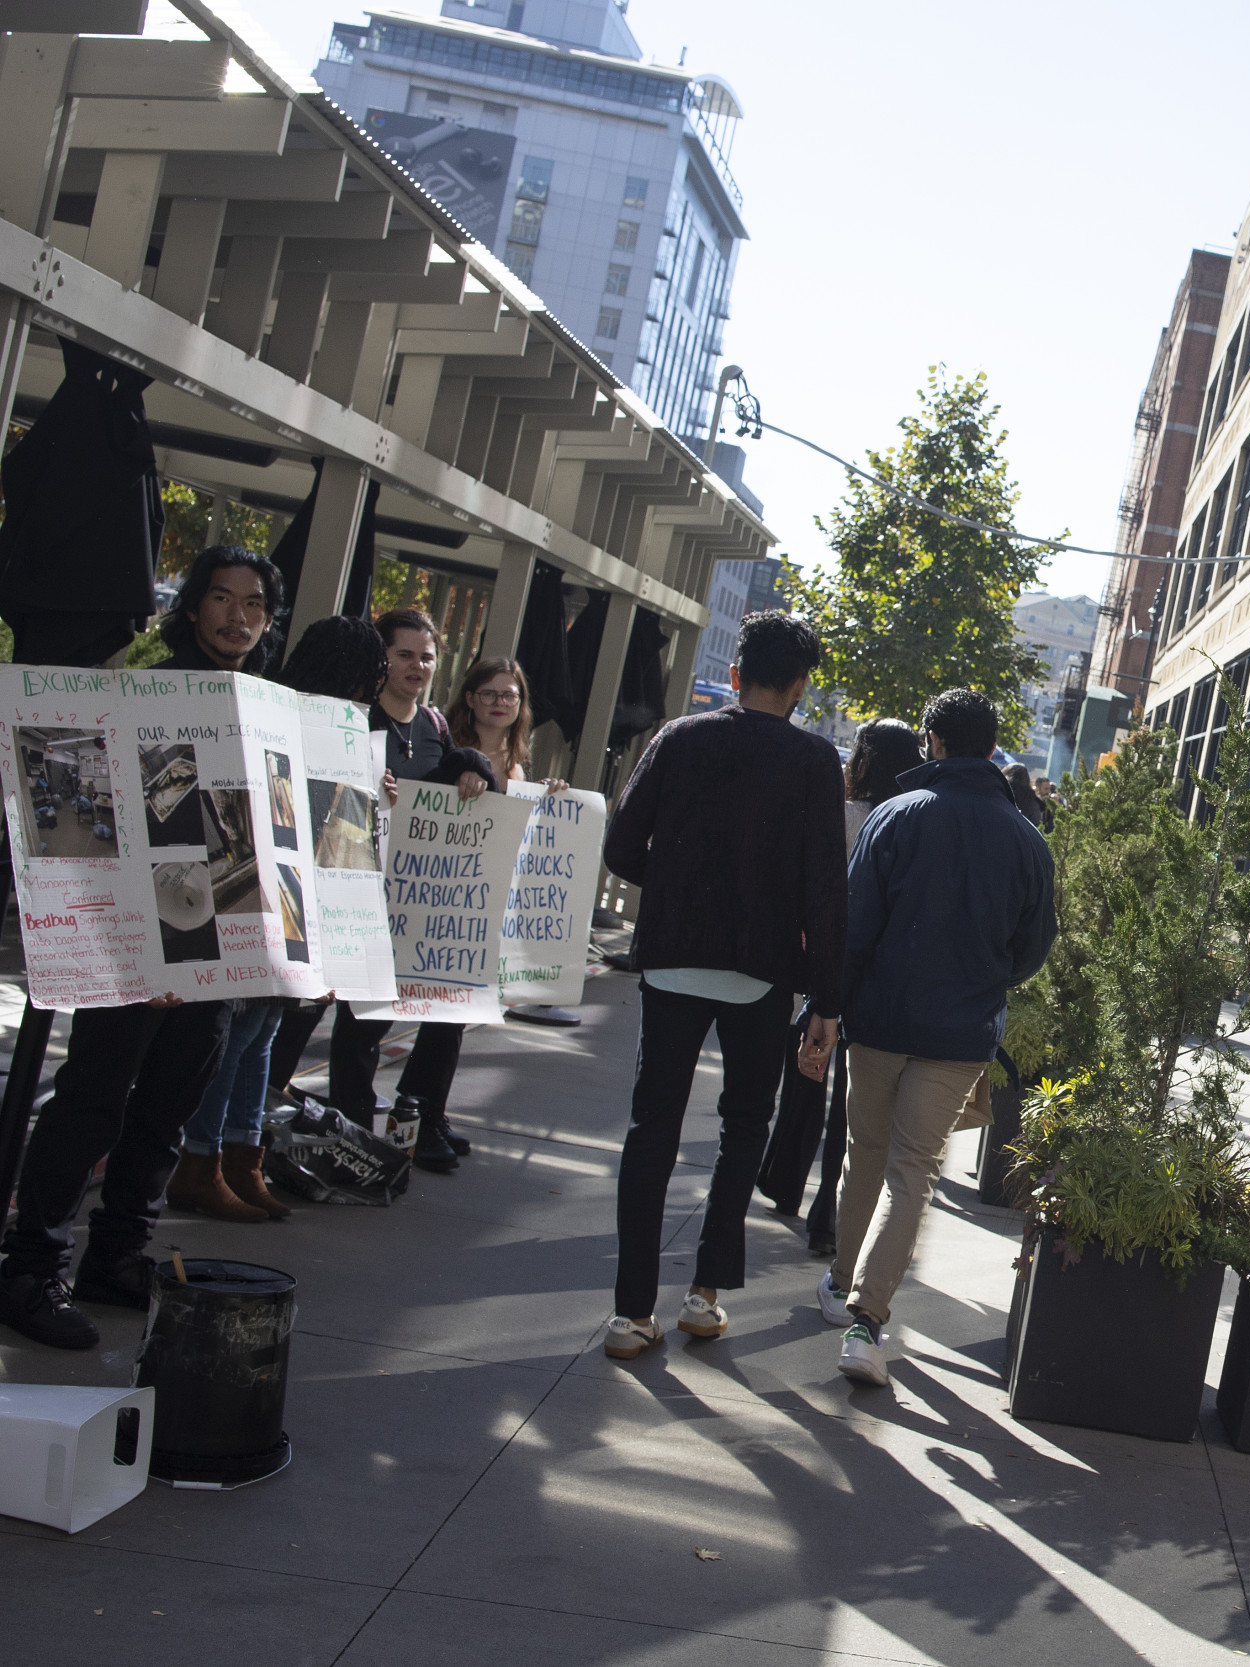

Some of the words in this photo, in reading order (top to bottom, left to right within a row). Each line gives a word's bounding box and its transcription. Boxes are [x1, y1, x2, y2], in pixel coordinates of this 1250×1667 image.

[119, 672, 177, 697] Photos
[186, 673, 234, 696] From
[137, 727, 170, 742] OUR
[344, 731, 356, 755] R
[412, 788, 479, 817] MOLD?
[515, 792, 584, 825] DARITY
[408, 816, 438, 842] BED
[445, 817, 494, 848] BUGS?
[393, 850, 484, 878] UNIONIZE
[513, 853, 575, 880] RBUCKS
[62, 890, 115, 905] Confirmed
[385, 878, 490, 910] STARBUCKS
[508, 884, 568, 913] OASTERY
[24, 912, 78, 934] Bedbug
[218, 923, 261, 937] Where
[388, 913, 407, 936] OR
[425, 914, 488, 942] HEALTH
[223, 938, 259, 952] Health
[95, 963, 114, 973] and
[116, 959, 137, 972] said
[413, 941, 487, 977] SAFETY!
[194, 967, 218, 986] WE
[226, 965, 268, 982] NEED
[497, 965, 563, 984] ERNATIONALIST
[397, 983, 474, 1004] NATIONALIST
[392, 1000, 432, 1017] GROUP
[313, 1143, 386, 1188] Marshall
[690, 1297, 706, 1309] NIKE
[613, 1319, 630, 1330] NIKE
